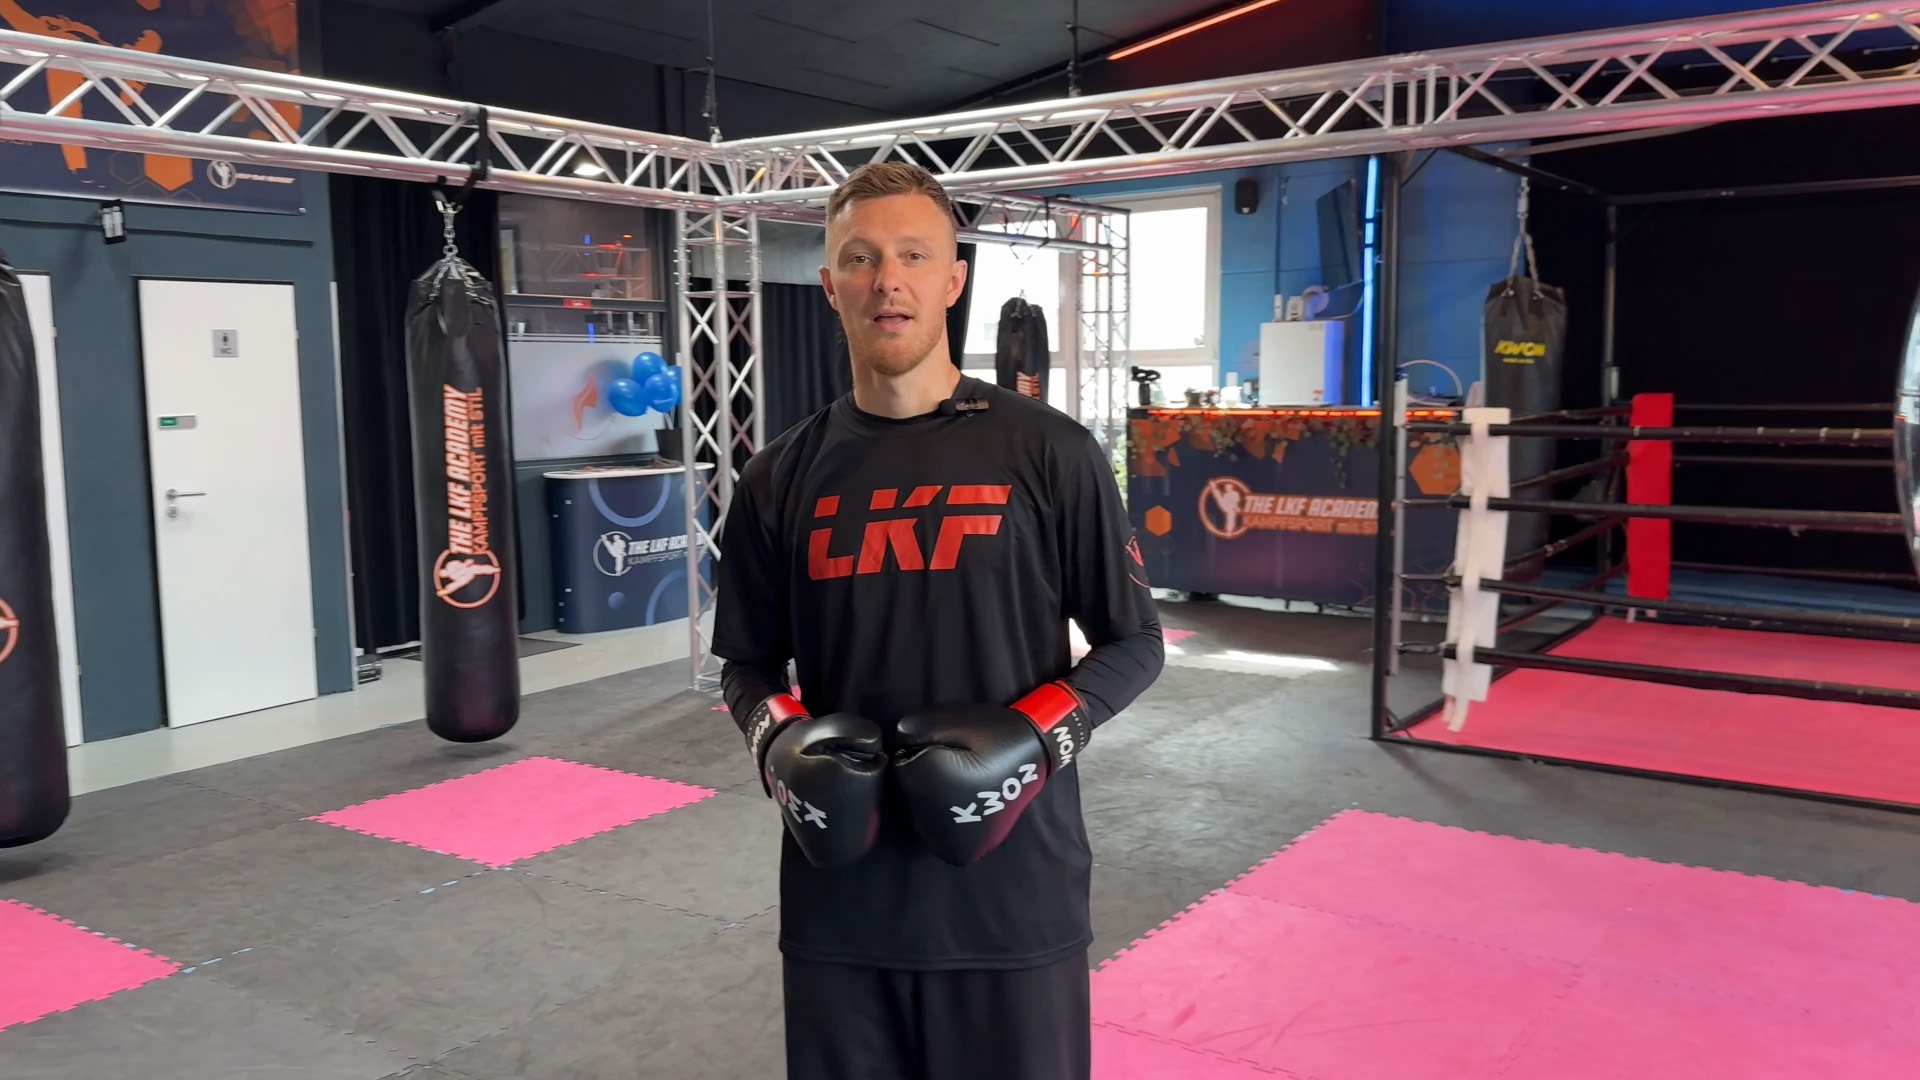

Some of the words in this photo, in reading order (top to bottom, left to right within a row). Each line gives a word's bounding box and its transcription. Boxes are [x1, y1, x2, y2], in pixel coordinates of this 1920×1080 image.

[1494, 340, 1546, 357] KWON
[466, 387, 485, 421] STIL
[443, 383, 471, 483] ACADEMY
[448, 481, 472, 519] LKF
[470, 451, 489, 555] KAMPFSPORT
[1244, 496, 1274, 514] THE
[1275, 497, 1308, 517] LKF
[1307, 498, 1379, 520] ACADEM
[449, 518, 473, 555] THE
[628, 540, 651, 556] THE
[649, 537, 670, 553] LKF
[808, 484, 1012, 580] LKF
[949, 763, 1039, 824] KWON
